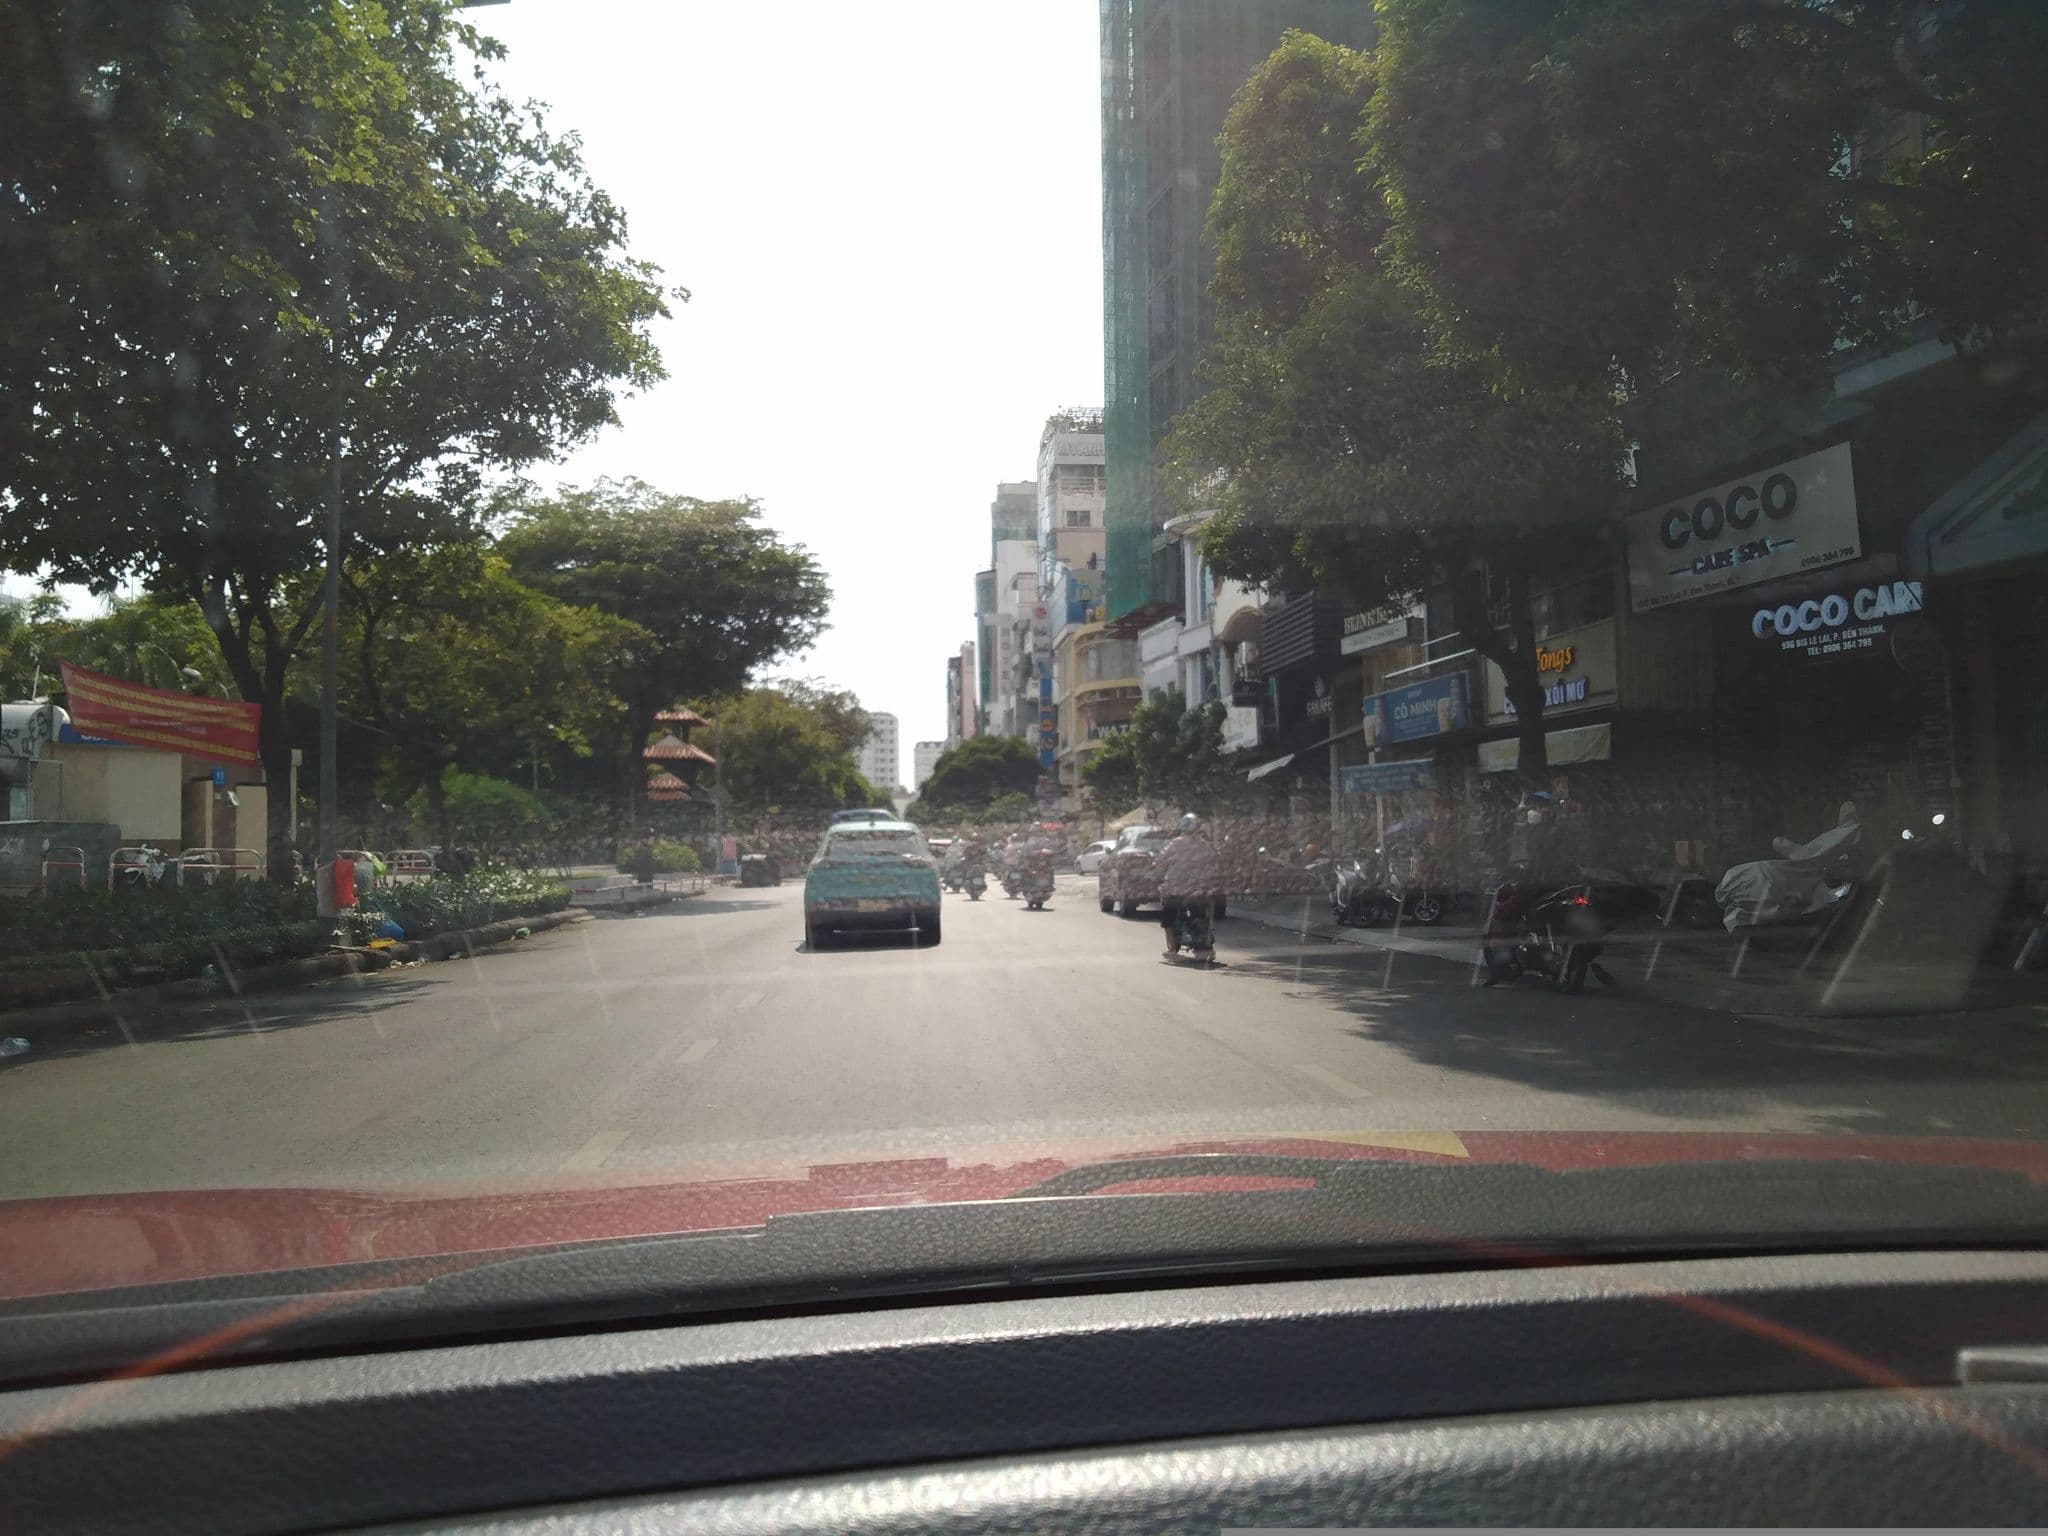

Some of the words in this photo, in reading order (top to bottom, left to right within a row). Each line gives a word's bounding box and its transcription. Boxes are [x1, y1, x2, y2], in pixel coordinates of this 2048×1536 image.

[1661, 473, 1797, 549] COCO
[1691, 548, 1734, 576] CARE
[1736, 539, 1769, 564] SPA
[1752, 594, 1849, 640] COCO
[1409, 697, 1438, 717] MINH
